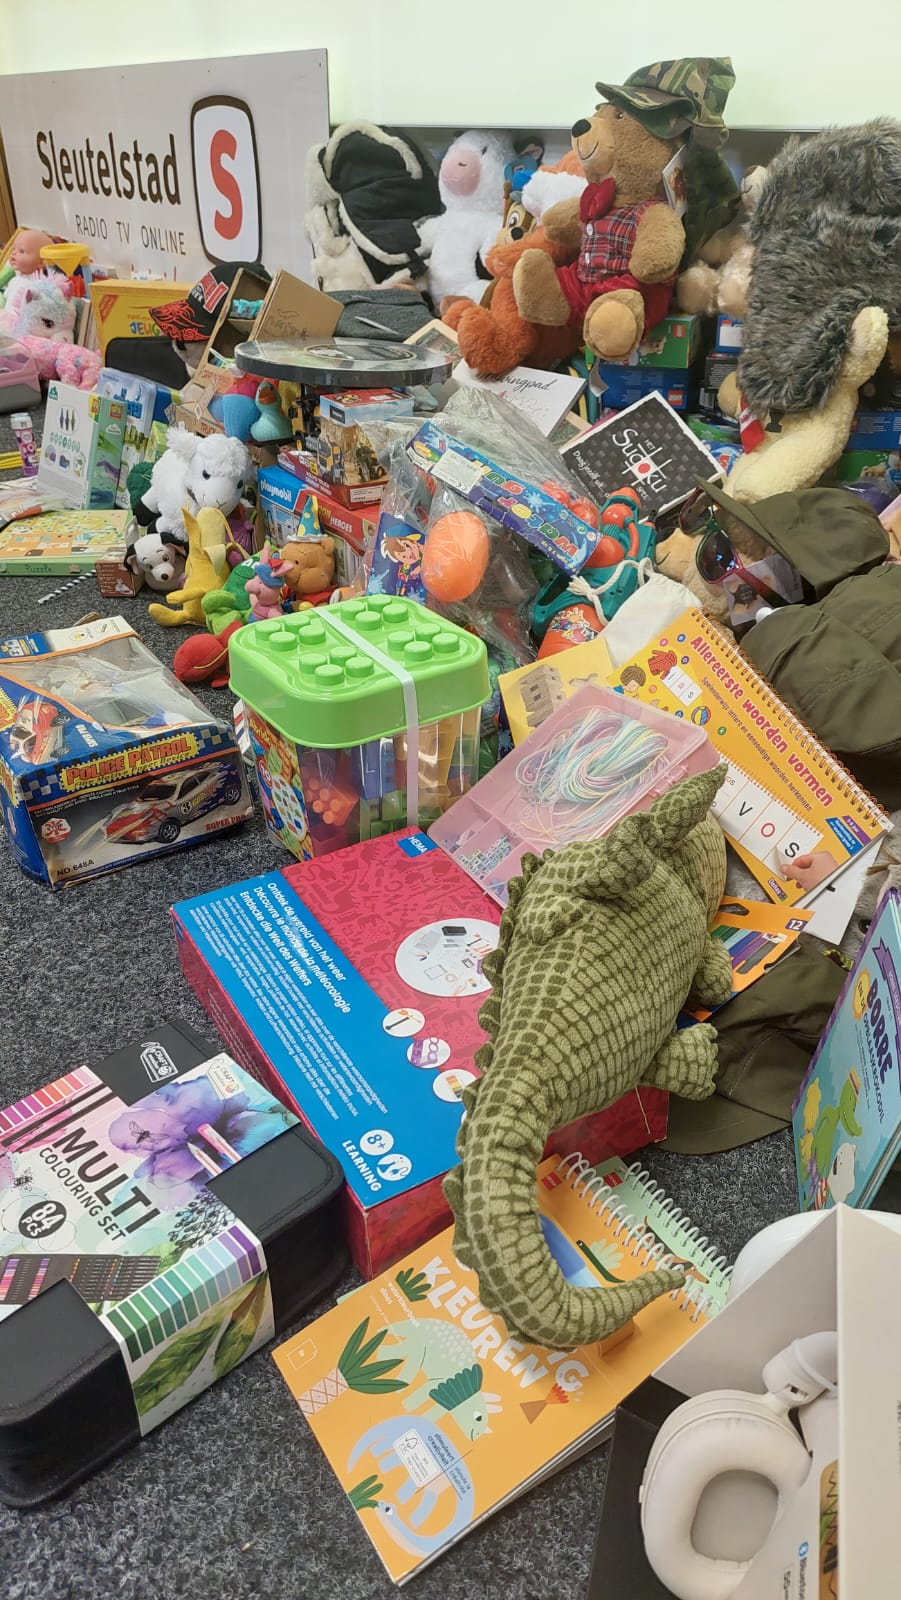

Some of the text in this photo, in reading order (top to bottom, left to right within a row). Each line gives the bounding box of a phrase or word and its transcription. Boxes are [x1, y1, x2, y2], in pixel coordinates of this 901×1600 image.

[36, 131, 181, 206] Sleutelstad
[210, 129, 243, 240] S
[75, 214, 186, 255] RADIO TV ONLINE
[260, 480, 293, 502] playmobil
[330, 517, 353, 533] HEROES
[689, 635, 834, 809] Allereerste woorden vormen
[65, 737, 192, 786] POLICE PATROL
[408, 836, 428, 854] HEMA
[240, 891, 312, 987] Entdecke die Welt des Wetters
[267, 882, 347, 982] Ontdek de wereld van het weer
[275, 916, 285, 926] le
[280, 924, 303, 950] monde
[297, 946, 309, 959] de
[304, 956, 316, 967] la
[789, 919, 803, 931] 12
[867, 977, 893, 1085] BORRE
[342, 1140, 382, 1192] LEARNING
[367, 1134, 386, 1149] 8+
[39, 1147, 127, 1242] COLOURING SET
[52, 1127, 161, 1234] MULTI
[21, 1216, 42, 1237] PCS
[32, 1202, 65, 1231] 84
[422, 1255, 549, 1388] KLEUREN
